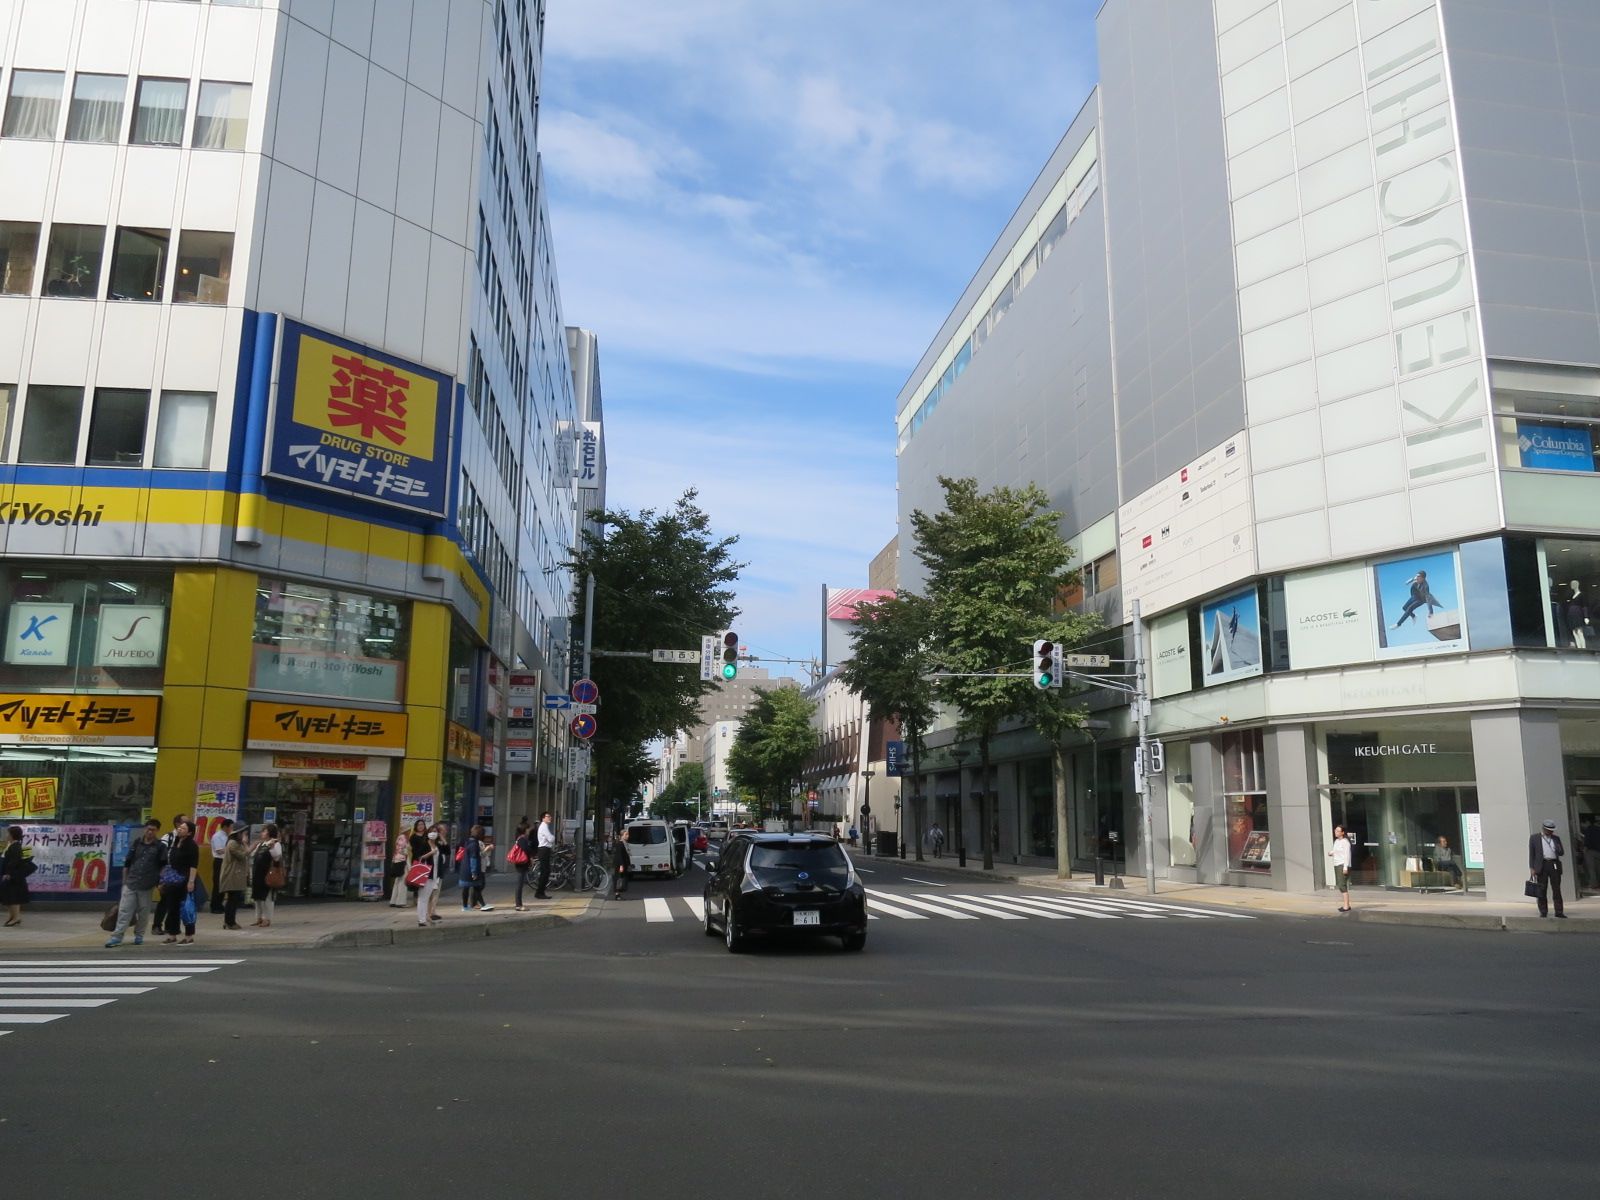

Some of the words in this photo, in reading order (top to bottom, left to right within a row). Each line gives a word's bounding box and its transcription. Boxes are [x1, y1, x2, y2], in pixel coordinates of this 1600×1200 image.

[328, 354, 410, 446] 薬
[320, 432, 362, 453] DRUG
[364, 447, 410, 468] STORE
[581, 429, 597, 480] 札石ビル
[1532, 435, 1585, 451] Columbia
[288, 445, 430, 498] マツモトキヨシ
[1300, 612, 1339, 623] LACOSTE
[18, 648, 53, 657] Kanebo
[104, 648, 155, 658] SHISEIDO
[1157, 648, 1176, 660] LACOSTE
[0, 699, 135, 730] マツモトキヨシ
[275, 710, 385, 741] マツモトキヨシ
[1355, 745, 1400, 757] IKEUCHI
[1402, 743, 1437, 754] GATE
[71, 856, 107, 890] 10
